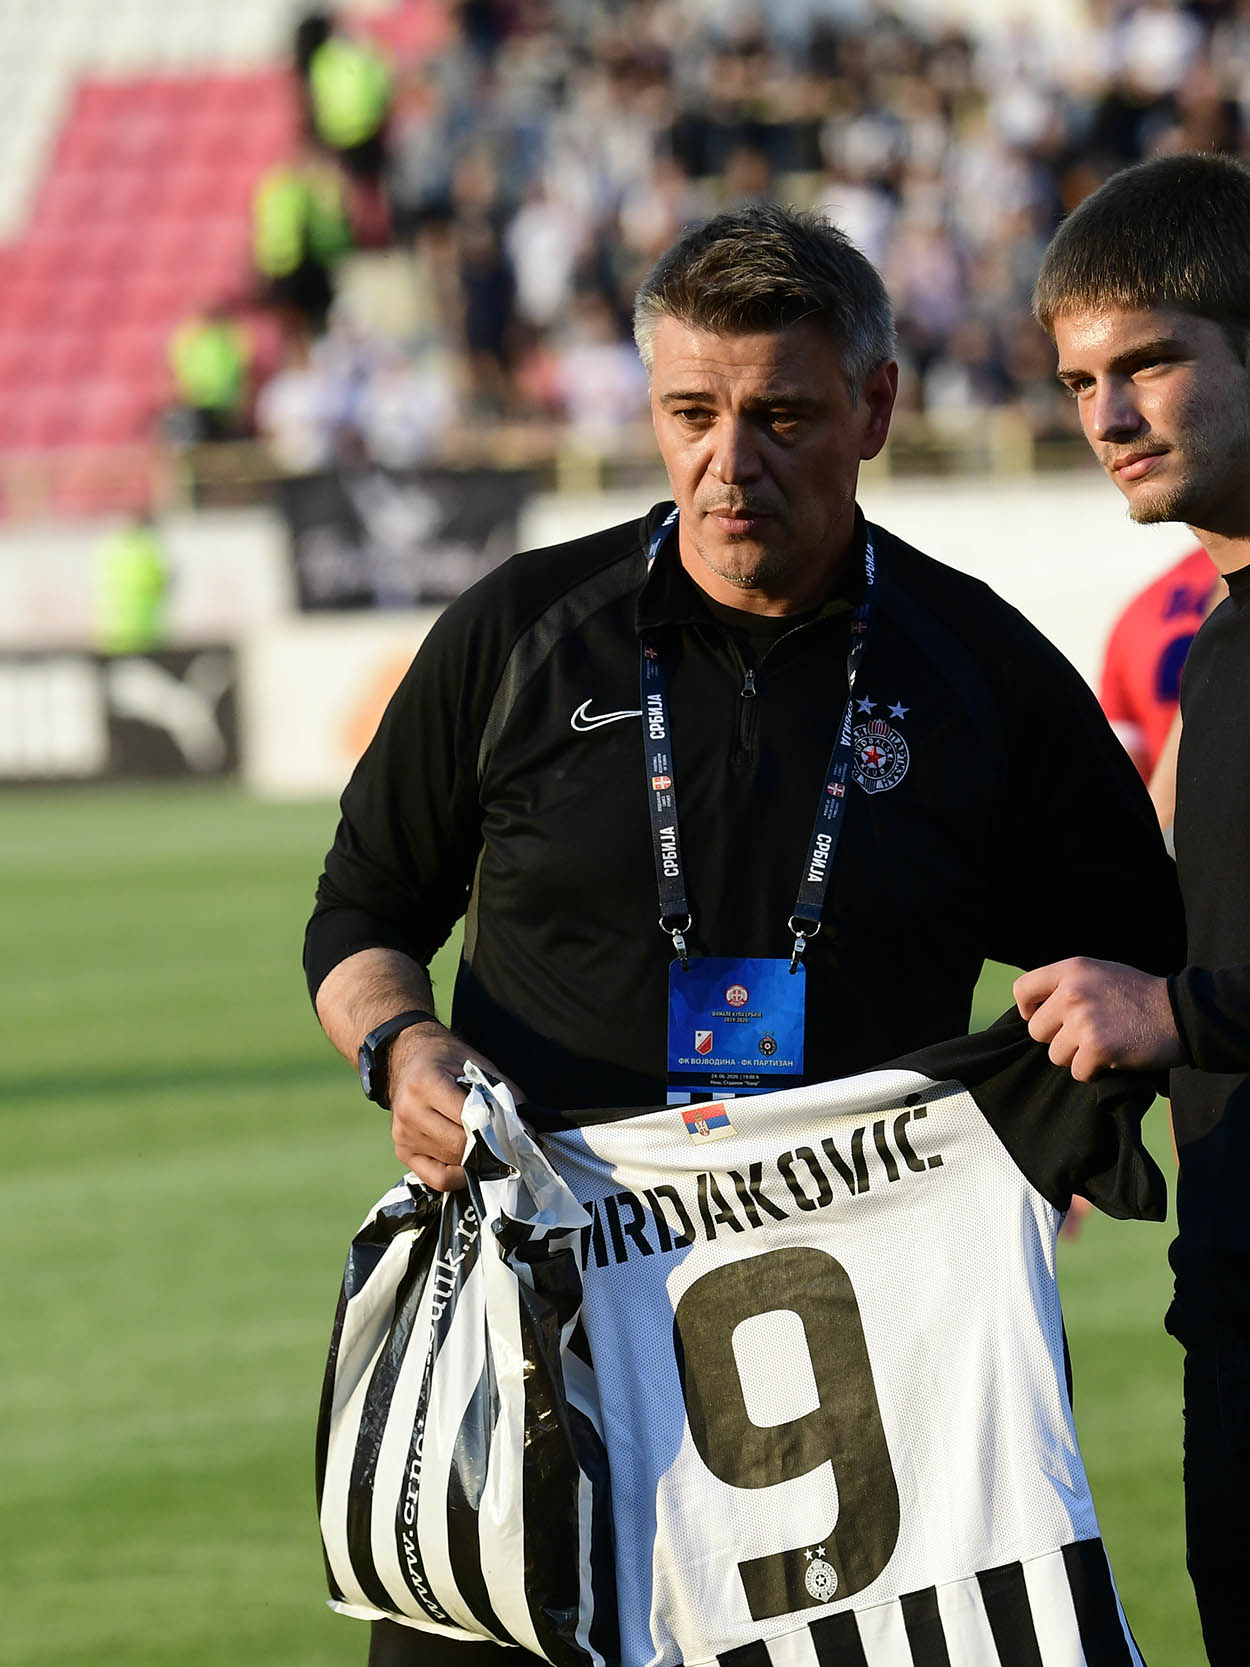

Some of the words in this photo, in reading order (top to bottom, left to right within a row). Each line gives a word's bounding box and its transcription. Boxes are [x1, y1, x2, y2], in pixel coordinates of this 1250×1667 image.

[647, 694, 666, 740] СРБИЈА
[659, 826, 680, 877] СРБИЈА
[807, 833, 832, 882] СРБИЈА
[678, 1057, 690, 1065] ФК
[690, 1058, 736, 1066] ВОЈВОДИНА
[753, 1059, 793, 1067] ПАРТИЗАН
[673, 1246, 900, 1621] 9
